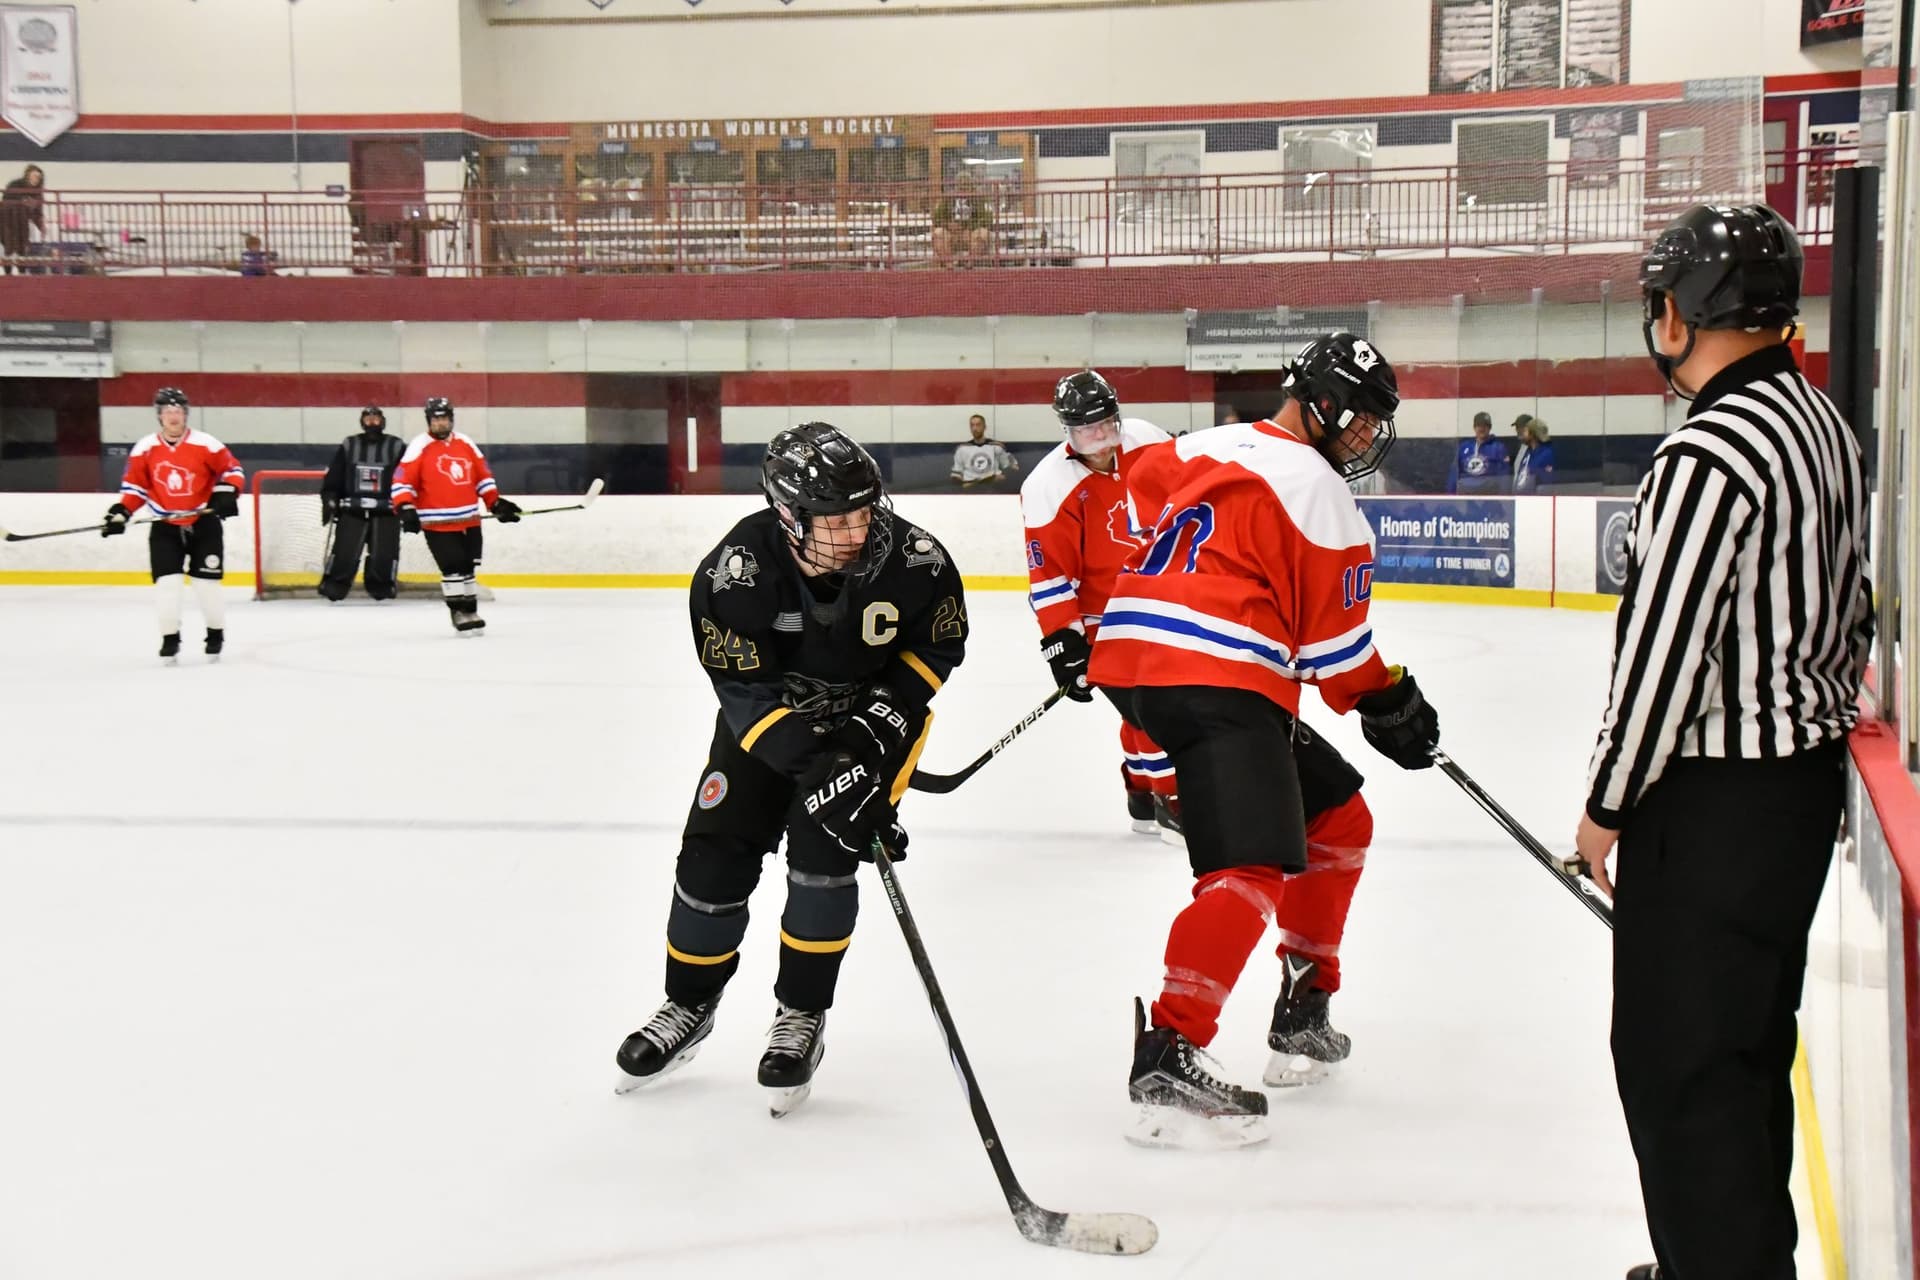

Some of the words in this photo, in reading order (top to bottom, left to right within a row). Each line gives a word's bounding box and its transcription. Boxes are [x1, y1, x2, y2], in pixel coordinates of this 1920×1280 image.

[607, 121, 711, 139] MINNESOTA
[725, 119, 808, 136] WOMEN'S
[823, 117, 894, 134] HOCKEY
[1230, 328, 1263, 337] BROOKS
[1380, 516, 1420, 537] Home
[1423, 516, 1437, 538] of
[1440, 516, 1510, 543] Champions
[1435, 557, 1442, 569] 6
[1443, 557, 1462, 569] TIME
[1462, 558, 1491, 570] WINNER
[1343, 562, 1375, 611] 10
[862, 601, 899, 646] C
[932, 596, 968, 644] 2
[701, 617, 760, 671] 24
[991, 703, 1047, 758] BAUER
[804, 764, 868, 815] AUER
[884, 880, 904, 915] BAUER
